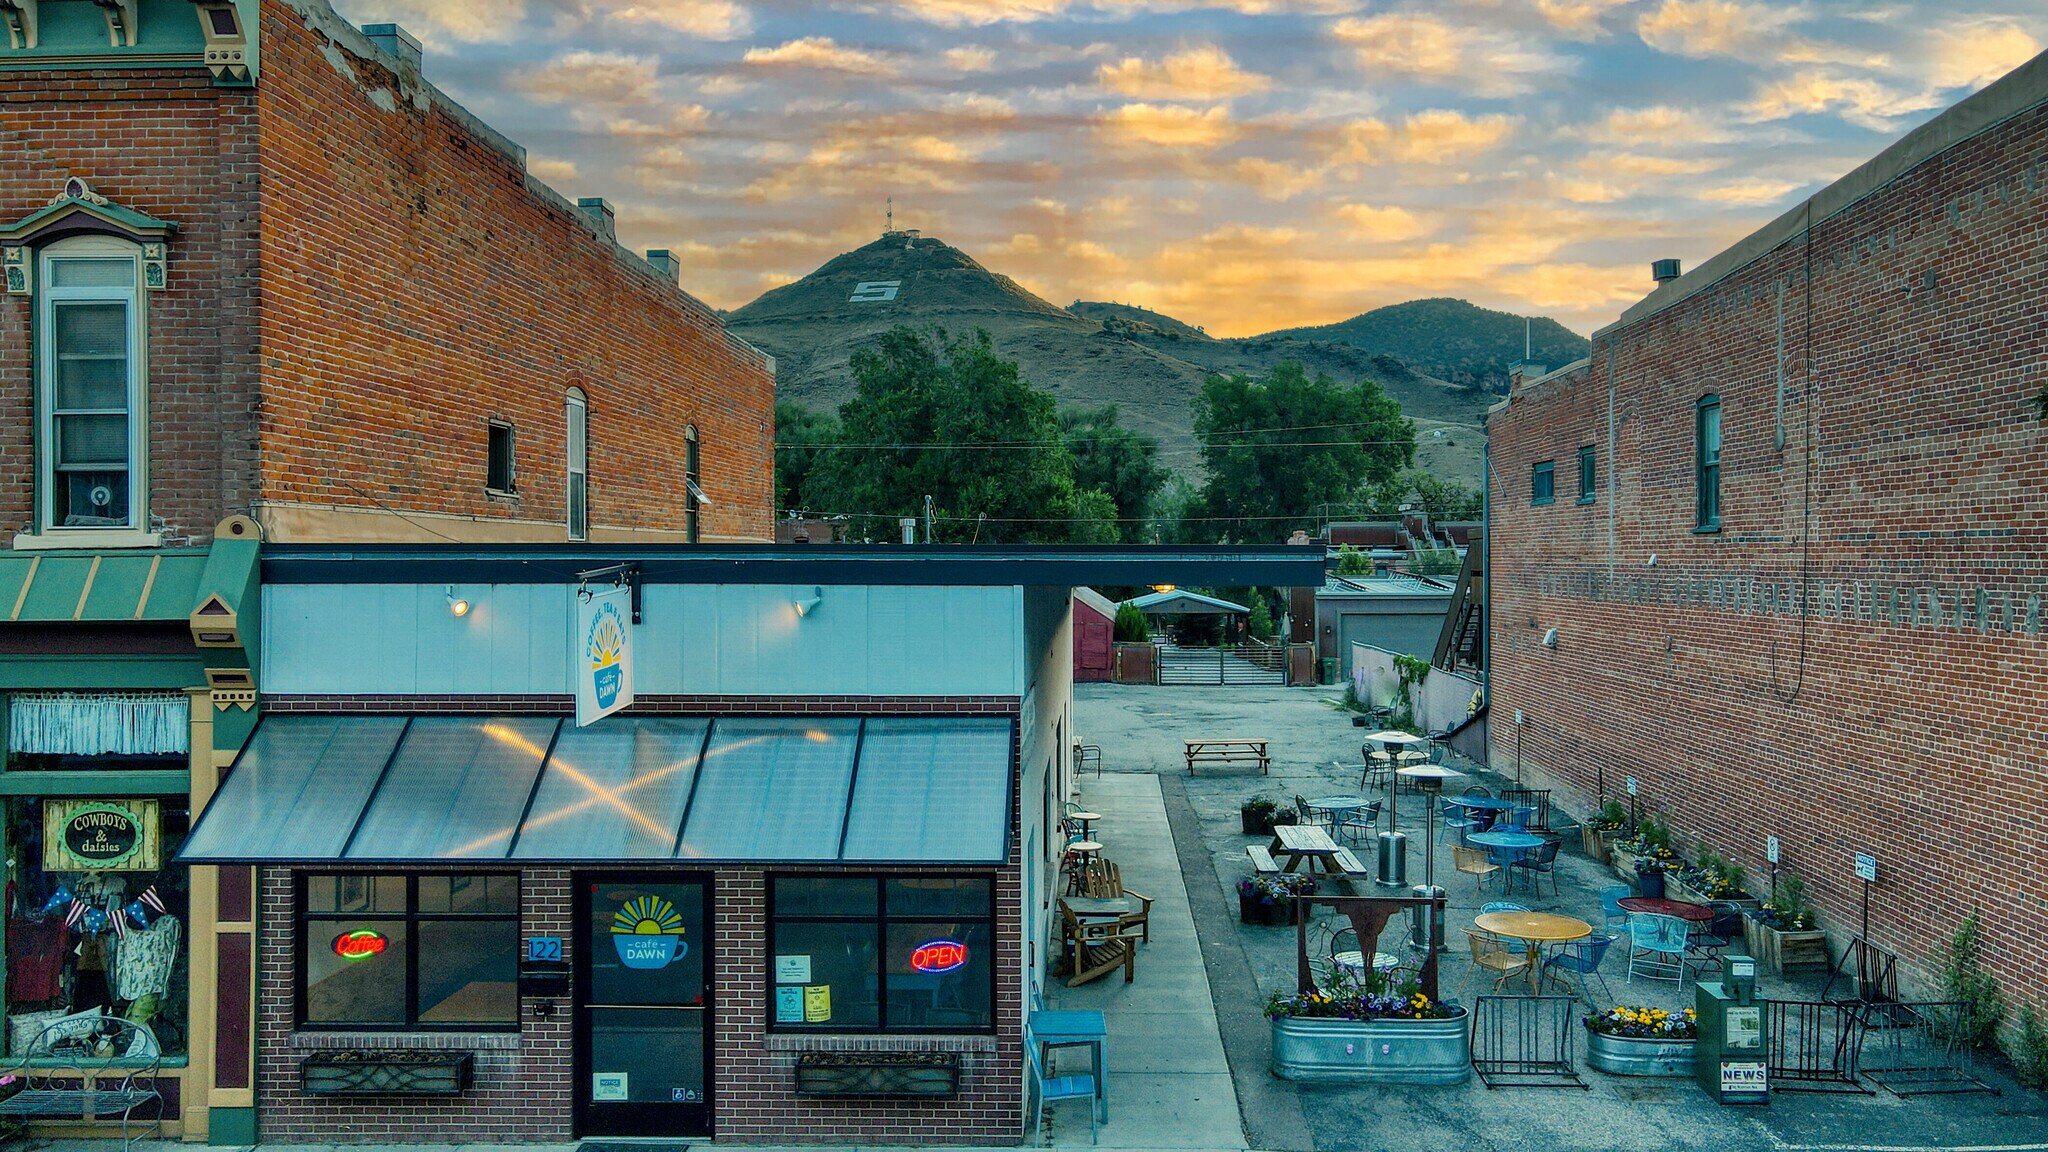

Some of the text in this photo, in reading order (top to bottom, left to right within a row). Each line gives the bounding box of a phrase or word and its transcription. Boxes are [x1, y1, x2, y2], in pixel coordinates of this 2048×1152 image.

[603, 601, 613, 613] TEA
[599, 682, 615, 699] DAWN
[74, 813, 127, 830] COWBOYS
[95, 829, 107, 842] &
[82, 839, 120, 852] daisies
[1857, 854, 1874, 867] NOTICE
[336, 933, 385, 955] Coffee
[528, 940, 558, 959] 122
[632, 938, 658, 949] café
[627, 949, 666, 960] DAWN
[911, 944, 965, 967] OPEN
[1723, 1070, 1764, 1081] NEWS
